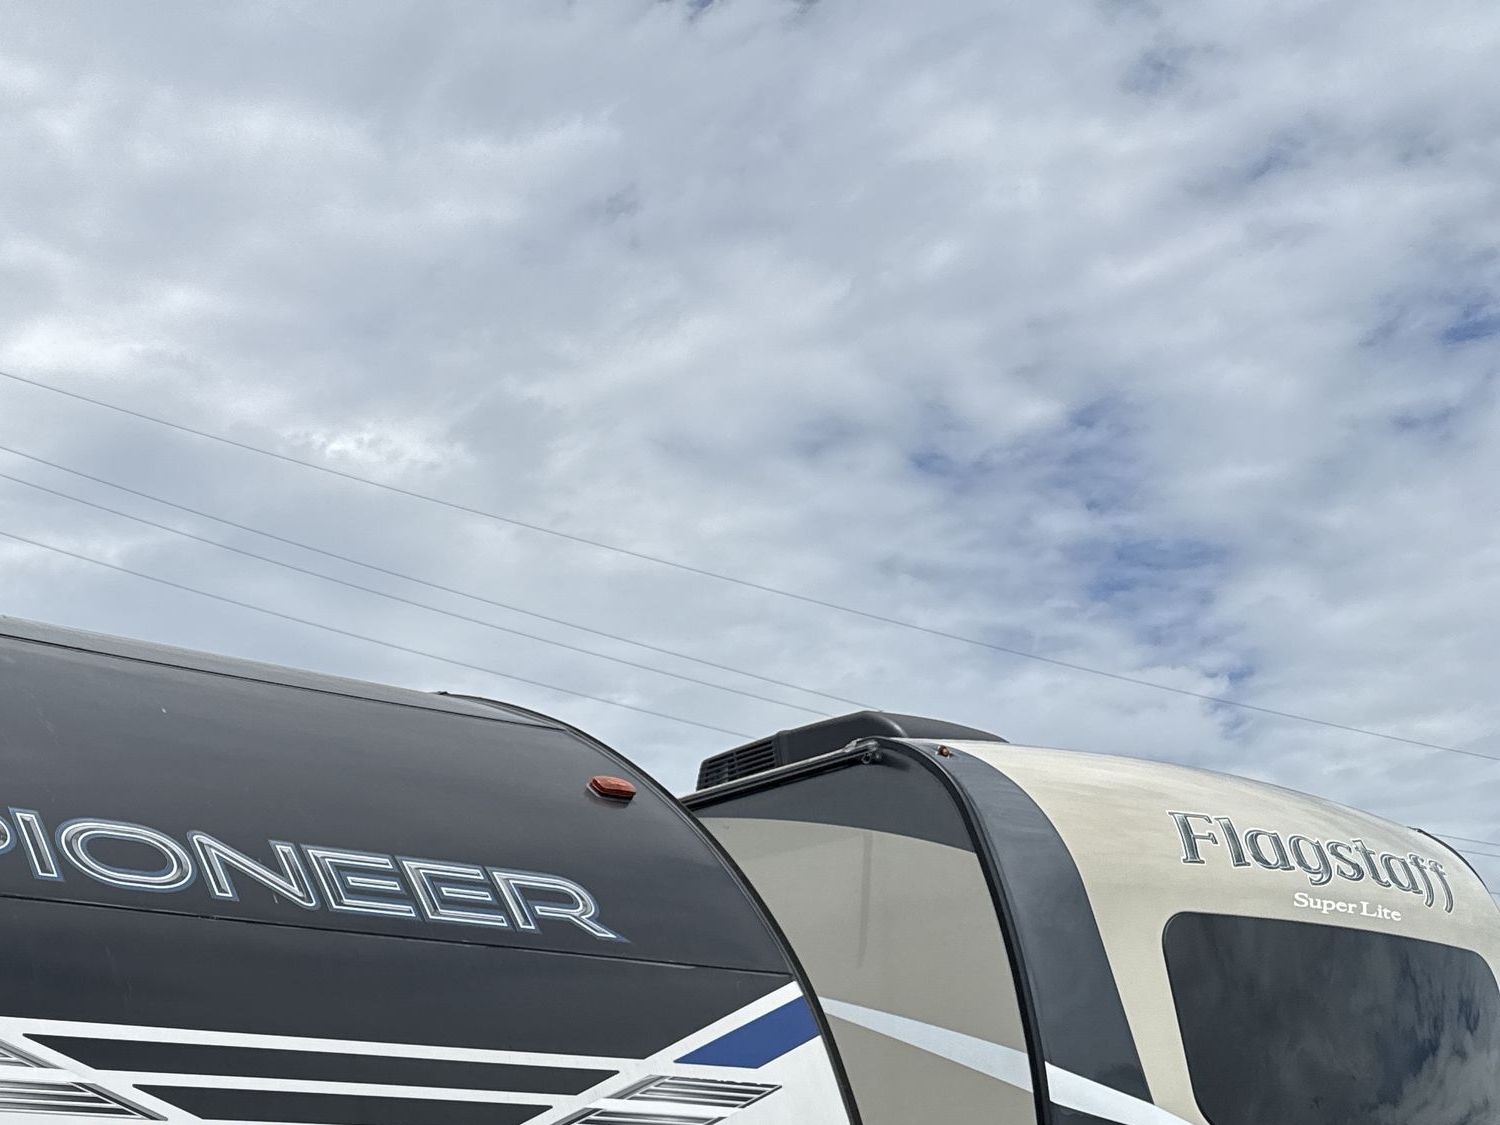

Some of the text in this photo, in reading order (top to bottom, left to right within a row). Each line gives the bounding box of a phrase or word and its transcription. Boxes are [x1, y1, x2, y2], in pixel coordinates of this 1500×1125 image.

[1166, 809, 1454, 914] Flagstaff
[1293, 892, 1402, 922] Super Lite
